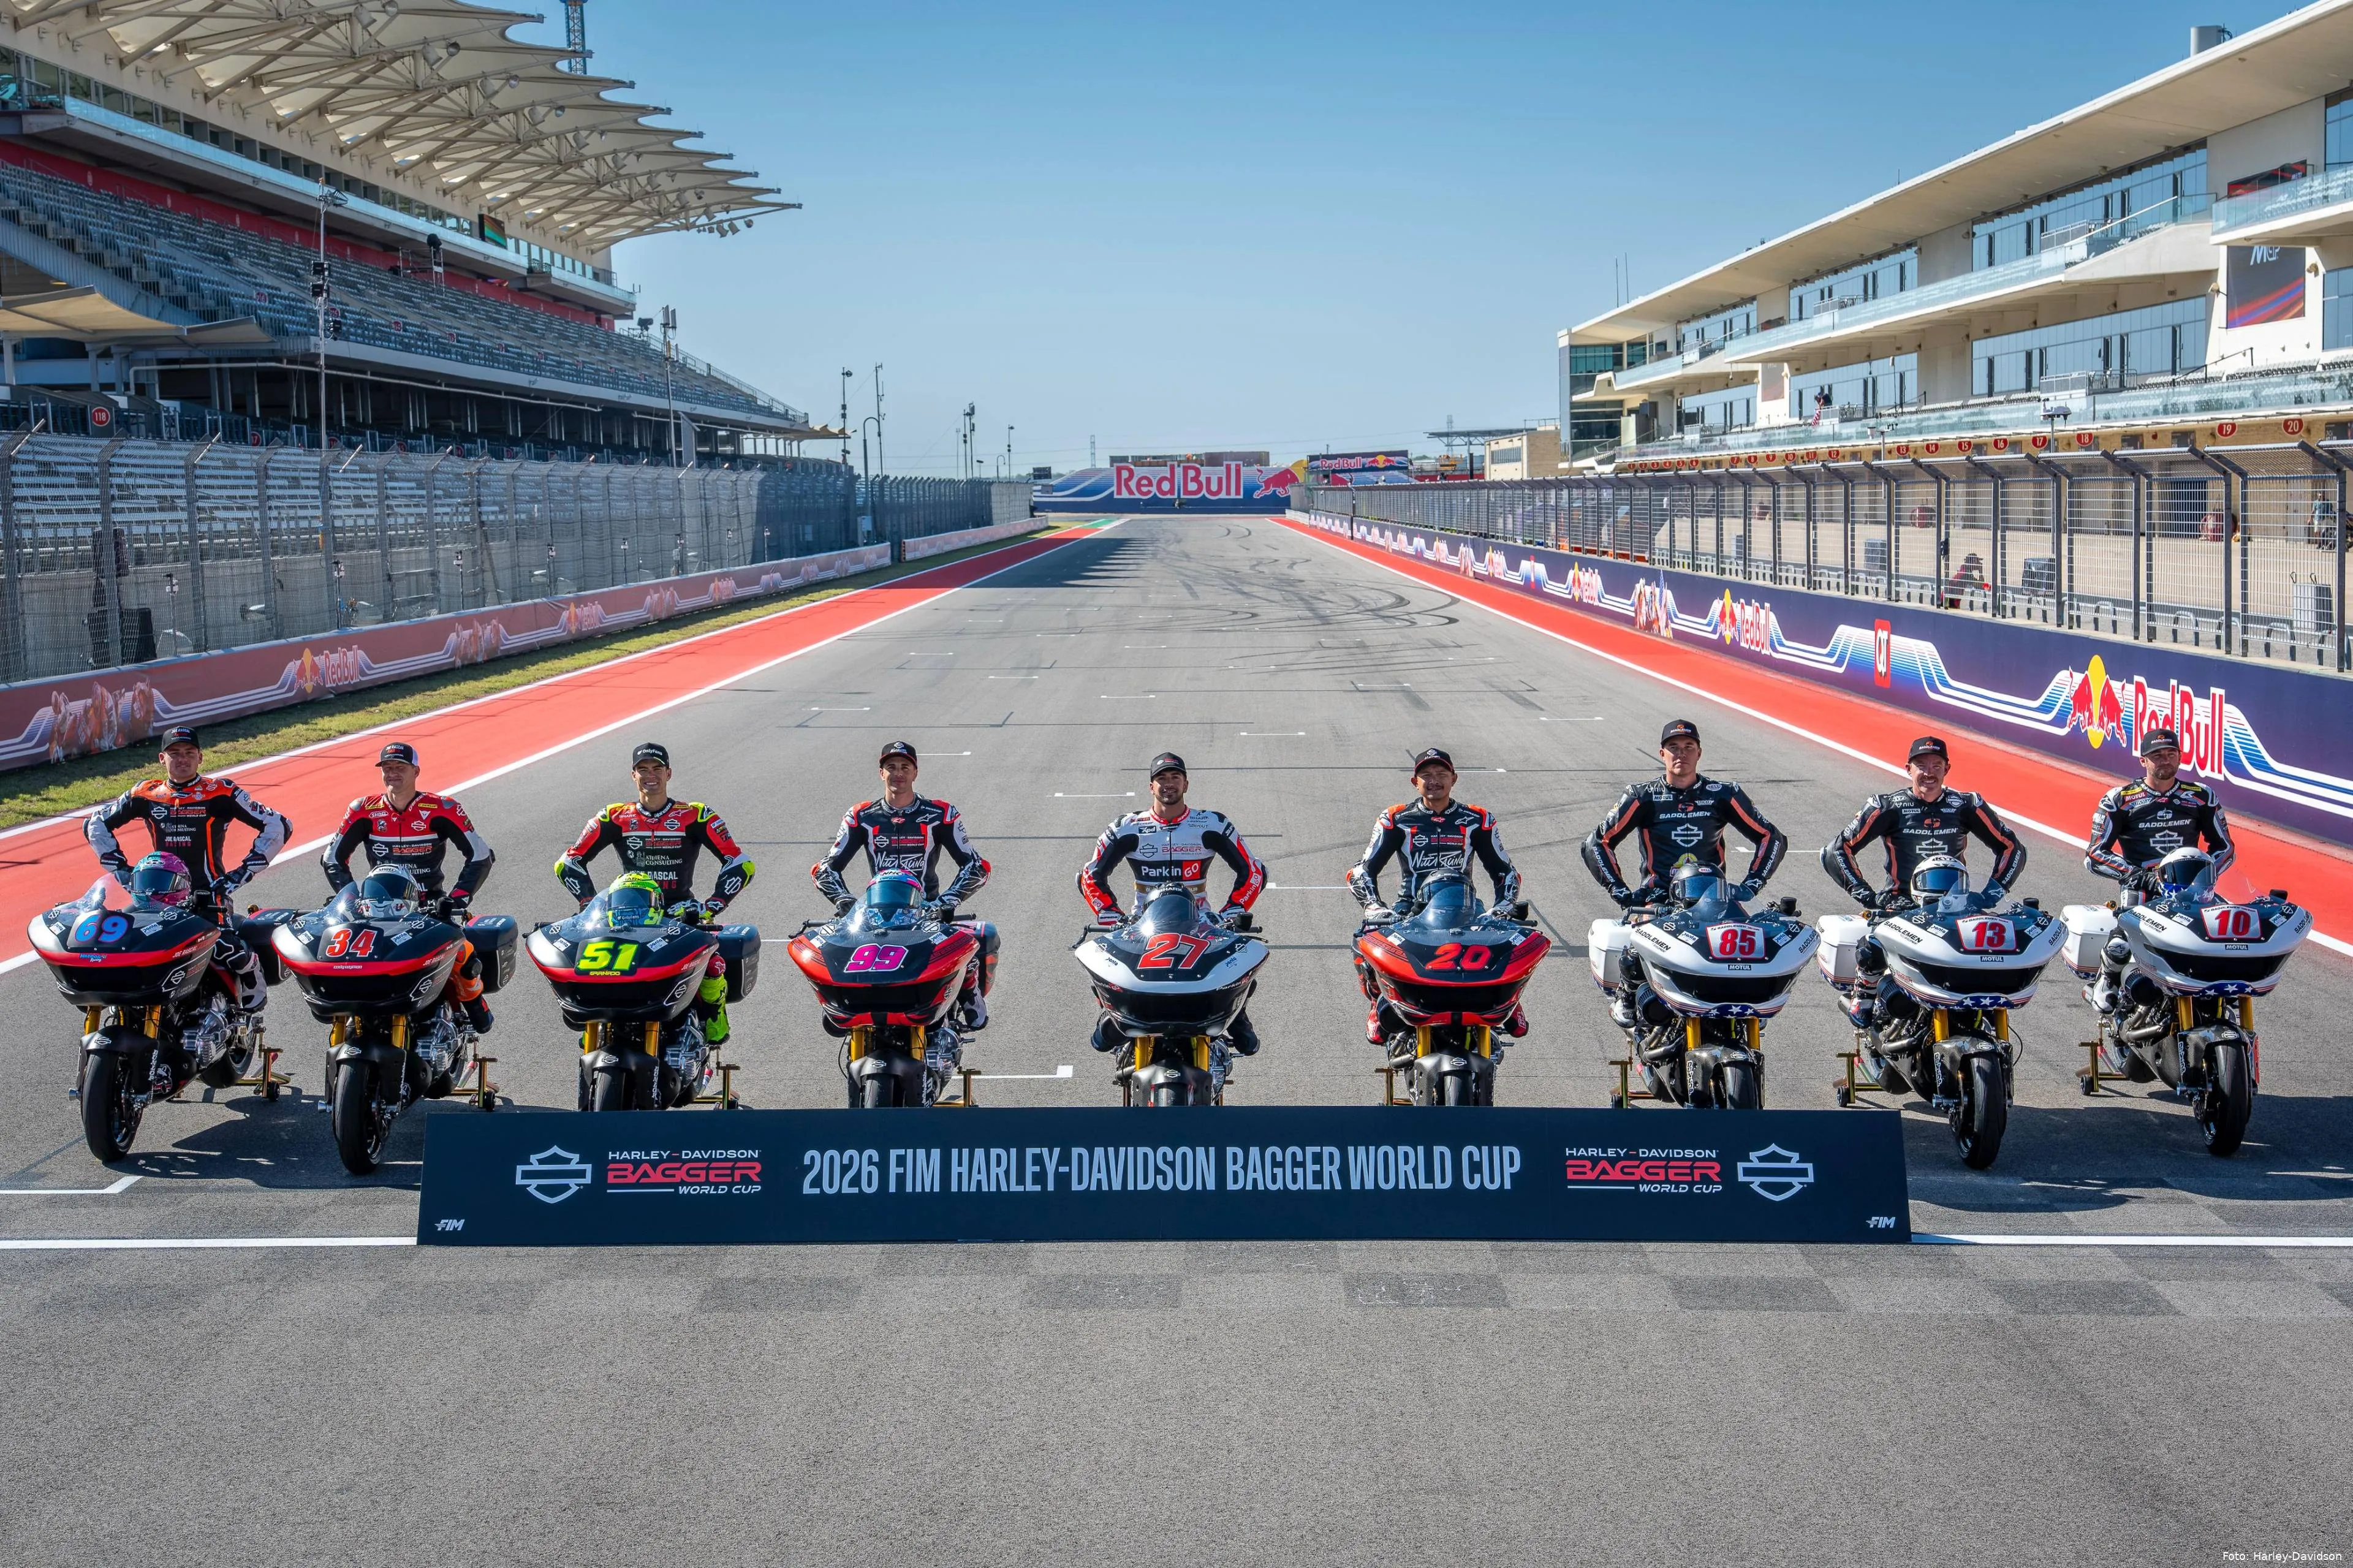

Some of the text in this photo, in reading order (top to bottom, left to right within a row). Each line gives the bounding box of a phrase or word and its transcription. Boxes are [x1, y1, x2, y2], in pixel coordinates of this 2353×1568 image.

[95, 412, 106, 422] 118
[2287, 420, 2299, 432] 20
[2081, 434, 2089, 444] 18
[2222, 425, 2232, 434] 19
[1900, 445, 1906, 454] 13
[1929, 444, 1935, 452] 14
[1997, 439, 2004, 448] 16
[2036, 437, 2043, 446] 17
[1320, 456, 1362, 469] Red Bull
[1115, 463, 1241, 497] Red Bull
[1740, 600, 1770, 653] Red Bull
[324, 645, 359, 687] Red Bull
[2180, 690, 2224, 775] Bull
[2125, 792, 2146, 802] MOTUL
[2139, 819, 2191, 828] SADDLEMEN
[1592, 846, 1615, 883] SADDLEMEN
[1835, 851, 1857, 884] SADDLEMEN
[75, 914, 129, 943] 69
[2128, 910, 2167, 931] SADDLEMEN
[2215, 909, 2251, 936] 10
[325, 928, 377, 958] 34
[1635, 928, 1672, 951] SADDLEMEN
[1719, 928, 1757, 956] 85
[1884, 920, 1923, 944] SADDLEMEN
[1972, 922, 2007, 948] 13
[577, 941, 638, 971] 51
[843, 943, 909, 972] 99
[1105, 956, 1119, 966] panta
[1137, 933, 1211, 969] 27
[1425, 942, 1491, 971] 20
[607, 1161, 762, 1183] BAGGER
[803, 1145, 1521, 1194] 2026 FIM HARLEY-DAVIDSON BAGGER WORLD CUP
[1565, 1160, 1721, 1181] BAGGER
[678, 1185, 761, 1194] WORLD CUP
[1639, 1184, 1722, 1194] WORLD CUP
[435, 1219, 464, 1231] FIM
[1866, 1216, 1896, 1229] FIM
